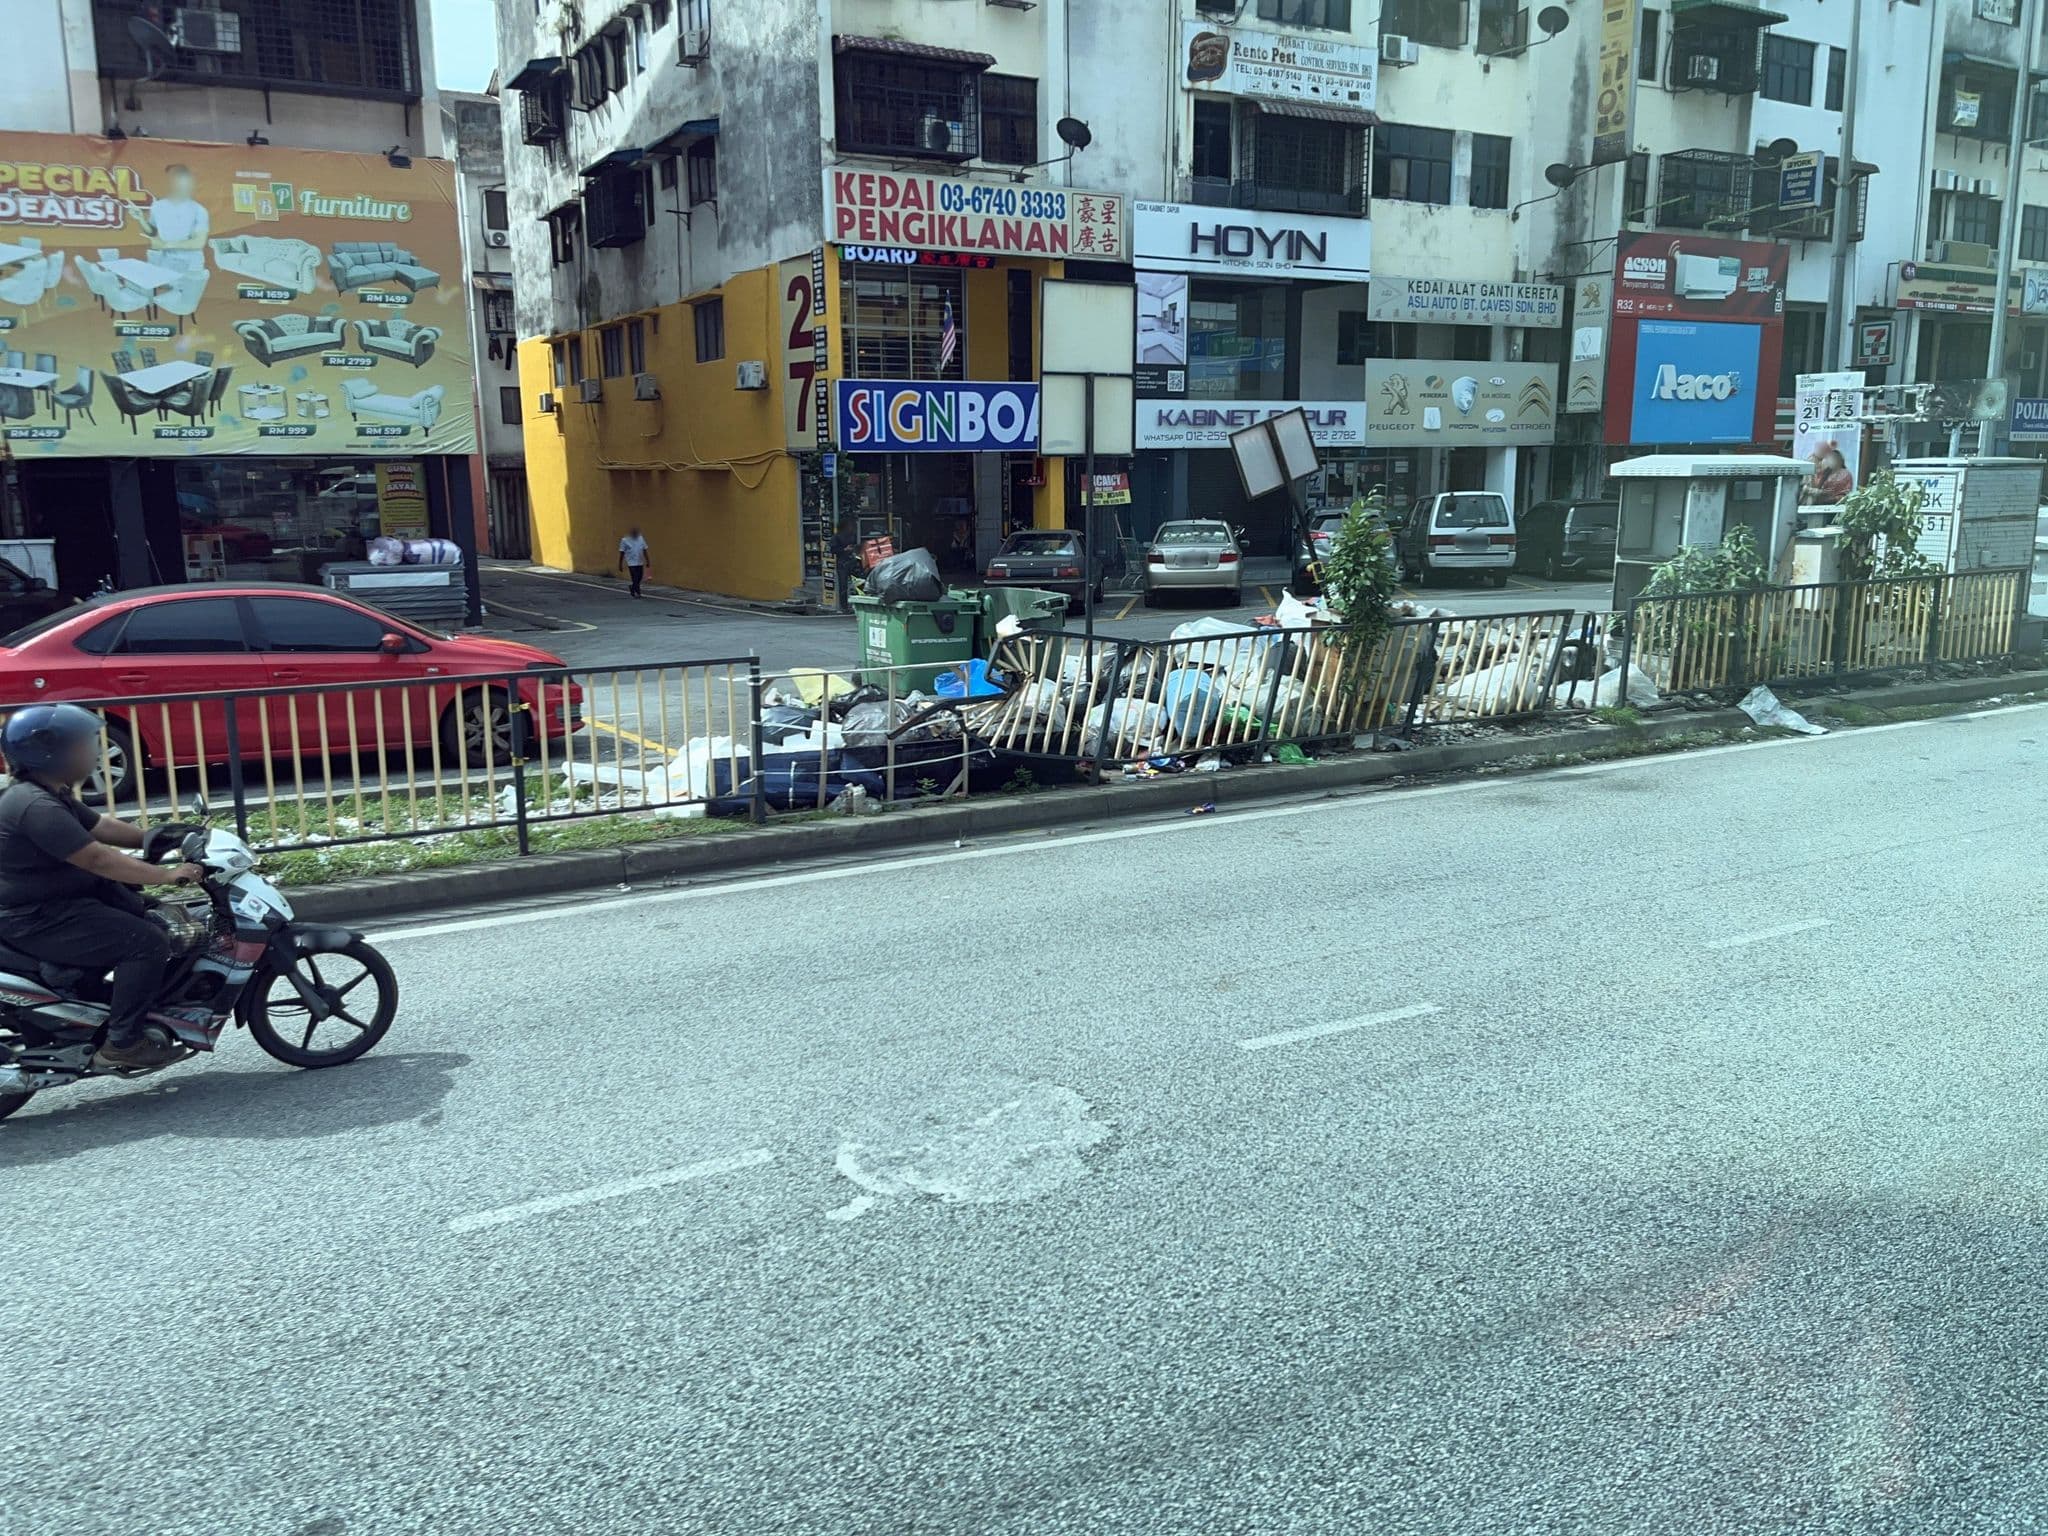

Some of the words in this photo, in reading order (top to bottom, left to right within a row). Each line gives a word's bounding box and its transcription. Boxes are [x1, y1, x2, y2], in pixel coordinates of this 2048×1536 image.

[1234, 42, 1268, 60] Rento
[1272, 47, 1296, 64] Pest
[834, 171, 935, 211] KEDAI
[940, 183, 1017, 216] 03-6740
[1021, 190, 1066, 220] 3333
[299, 189, 411, 220] Furniture
[836, 207, 1068, 254] PENGIKLANAN
[1191, 221, 1327, 262] HOYIN
[843, 245, 917, 264] BOARD
[1624, 257, 1667, 272] ACSON
[247, 290, 264, 298] RM
[266, 290, 290, 299] 1699
[1408, 280, 1443, 295] KEDAI
[1447, 283, 1476, 297] ALAT
[1480, 284, 1513, 298] GANTI
[1517, 286, 1559, 300] KERETA
[366, 294, 383, 302] RM
[385, 295, 408, 303] 1499
[1407, 295, 1430, 309] ASLI
[1431, 297, 1458, 310] AUTO
[1459, 297, 1478, 311] (BT.
[1480, 298, 1513, 313] CAVES)
[1515, 301, 1536, 313] SDN.
[1537, 302, 1557, 314] BHD
[1616, 299, 1634, 310] R32
[122, 326, 141, 335] RM
[329, 356, 346, 365] RM
[348, 357, 372, 366] 2799
[1803, 394, 1854, 404] NOVMER
[1803, 406, 1819, 419] 21
[1834, 404, 1854, 418] 23
[1157, 409, 1260, 427] KABINET
[1268, 409, 1347, 427] PUR
[268, 426, 286, 435] RM
[288, 427, 307, 435] 999
[366, 426, 382, 435] RM
[384, 427, 402, 435] 599
[1368, 423, 1415, 431] PEUGEOT
[1448, 423, 1479, 431] PROTON
[11, 429, 31, 438] RM
[161, 429, 180, 437] RM
[182, 429, 208, 437] 2699
[1143, 433, 1184, 442] WHATSAPP
[1185, 431, 1228, 441] 012-259
[1331, 430, 1357, 441] 2782
